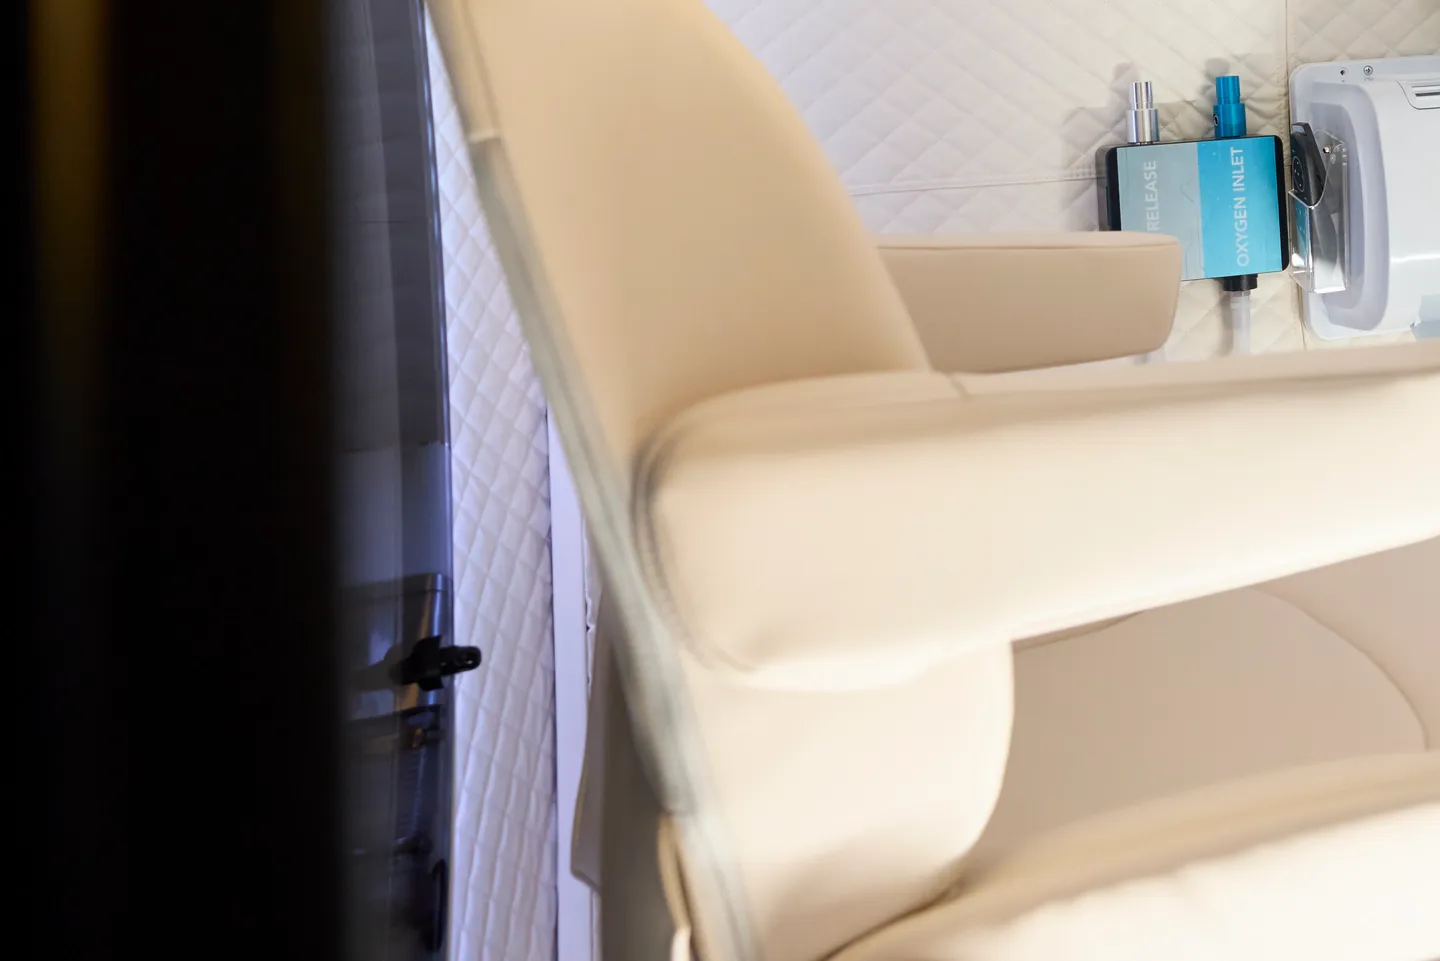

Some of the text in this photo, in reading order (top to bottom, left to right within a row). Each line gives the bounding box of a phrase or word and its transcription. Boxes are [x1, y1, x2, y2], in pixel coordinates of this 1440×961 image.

[1144, 160, 1159, 232] RELEASE
[1230, 147, 1250, 267] OXYGEN INLET
